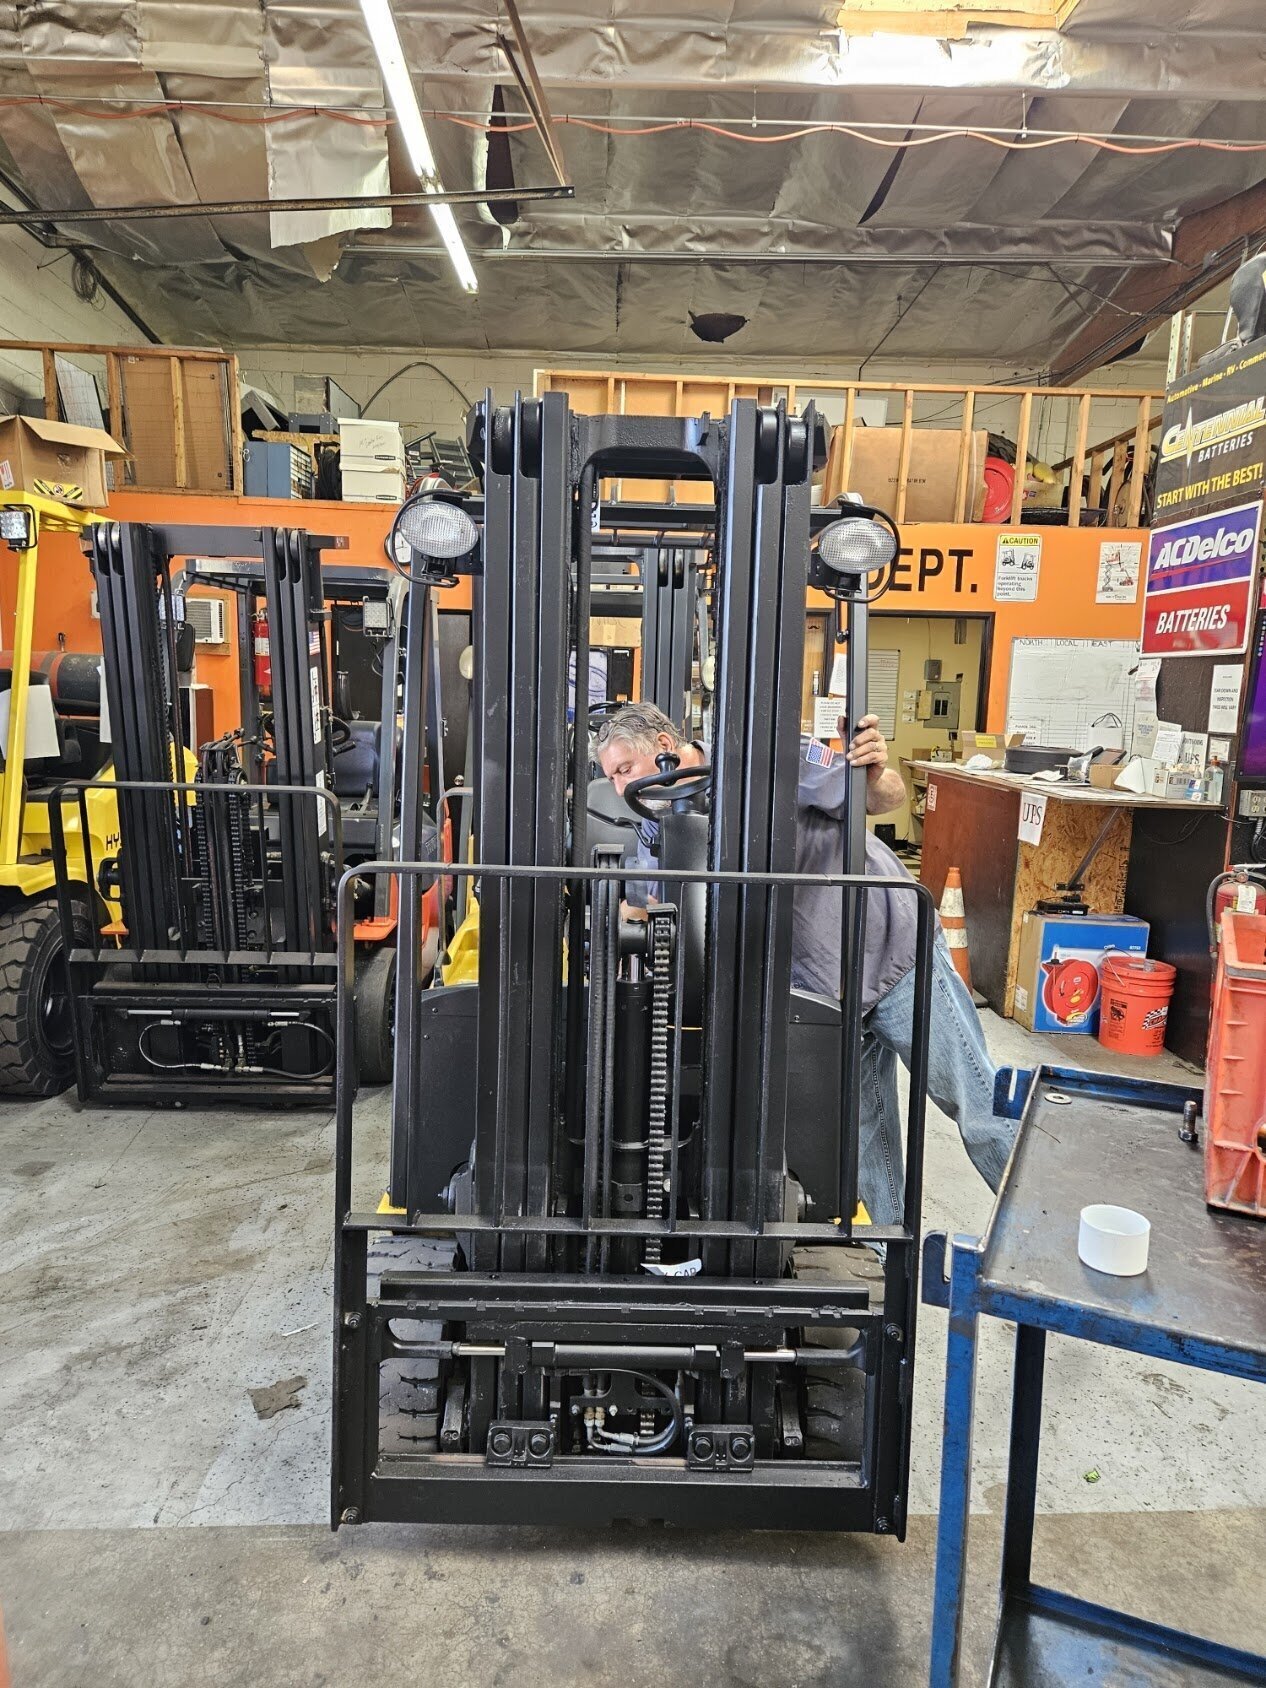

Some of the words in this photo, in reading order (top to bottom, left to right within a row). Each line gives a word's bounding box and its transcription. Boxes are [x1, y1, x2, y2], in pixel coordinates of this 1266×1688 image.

[1167, 383, 1198, 403] Automotive
[1202, 372, 1222, 387] Marine
[1226, 365, 1236, 376] RV
[1162, 396, 1266, 457] CENTENNIAL
[1198, 432, 1253, 463] BATTERIES
[1157, 490, 1183, 509] START
[1185, 481, 1210, 501] WITH
[1211, 474, 1231, 491] THE
[1232, 462, 1264, 487] BEST!
[1153, 527, 1254, 571] ACDelco
[1155, 604, 1231, 635] BATTERIES
[1020, 639, 1043, 647] NORTH
[1023, 803, 1042, 826] UPS
